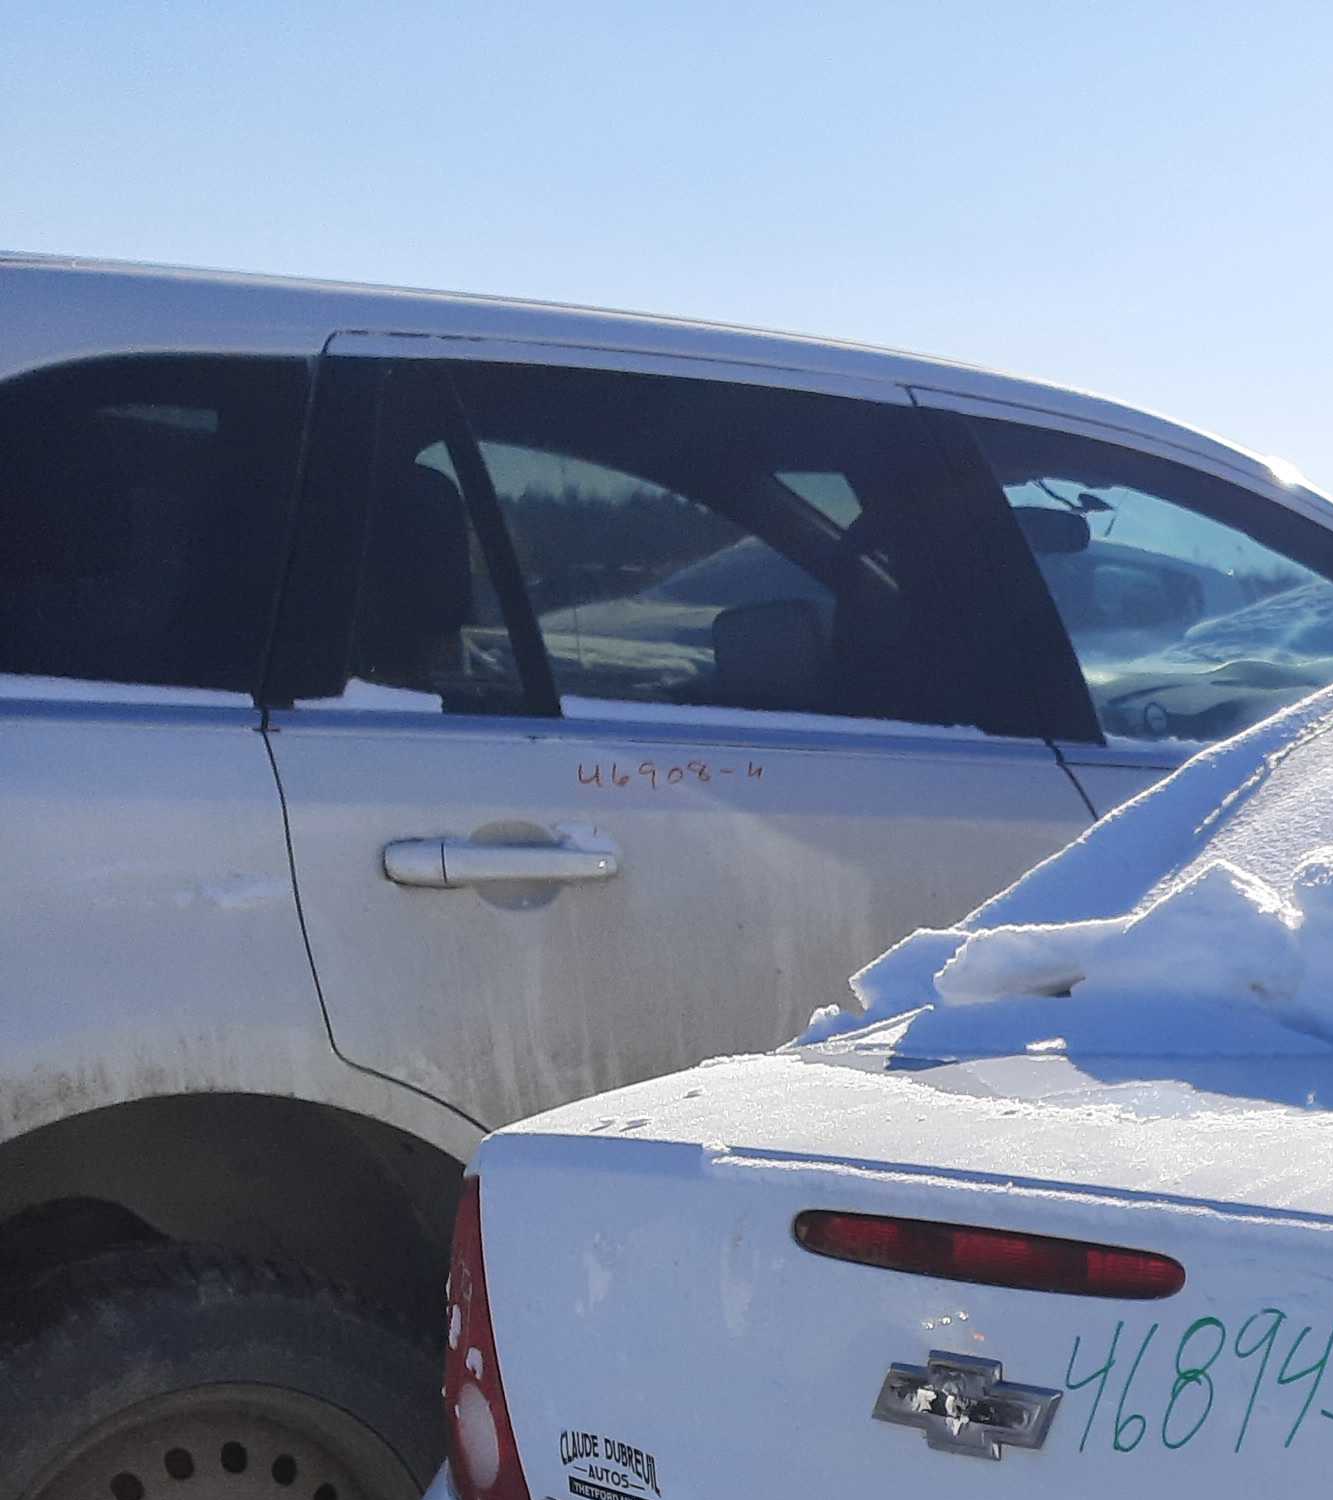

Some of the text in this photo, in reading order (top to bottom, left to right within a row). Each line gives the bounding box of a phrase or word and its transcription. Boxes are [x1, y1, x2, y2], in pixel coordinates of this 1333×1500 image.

[559, 1430, 662, 1498] CLAUDE DUBREUIL
[588, 1463, 630, 1489] AUTOS
